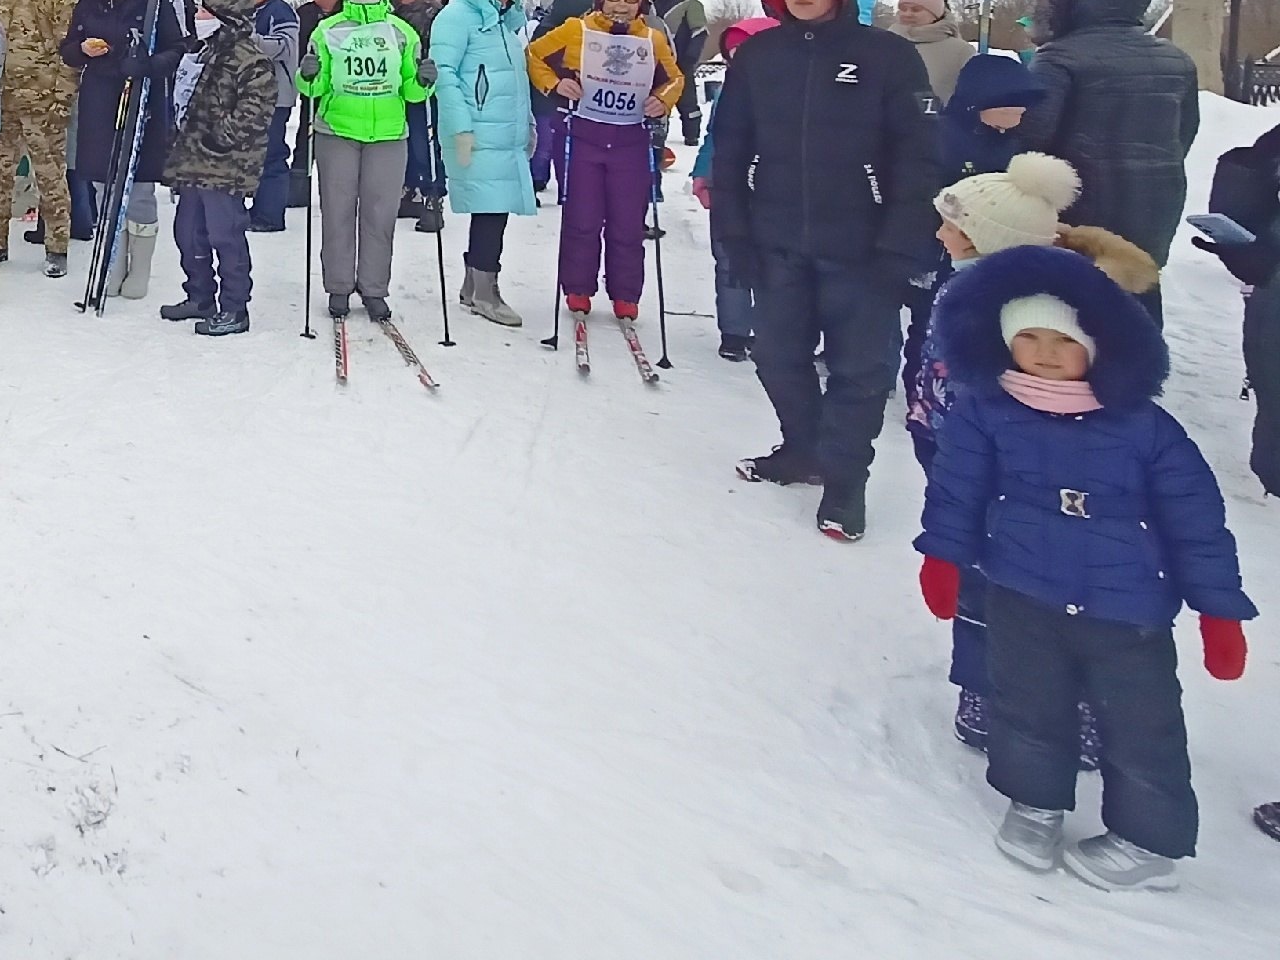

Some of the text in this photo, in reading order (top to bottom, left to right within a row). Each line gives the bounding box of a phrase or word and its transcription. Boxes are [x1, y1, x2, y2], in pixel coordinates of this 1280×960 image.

[343, 55, 388, 77] 1304
[837, 63, 858, 78] Z
[592, 88, 636, 111] 4056
[863, 163, 874, 175] ЗА
